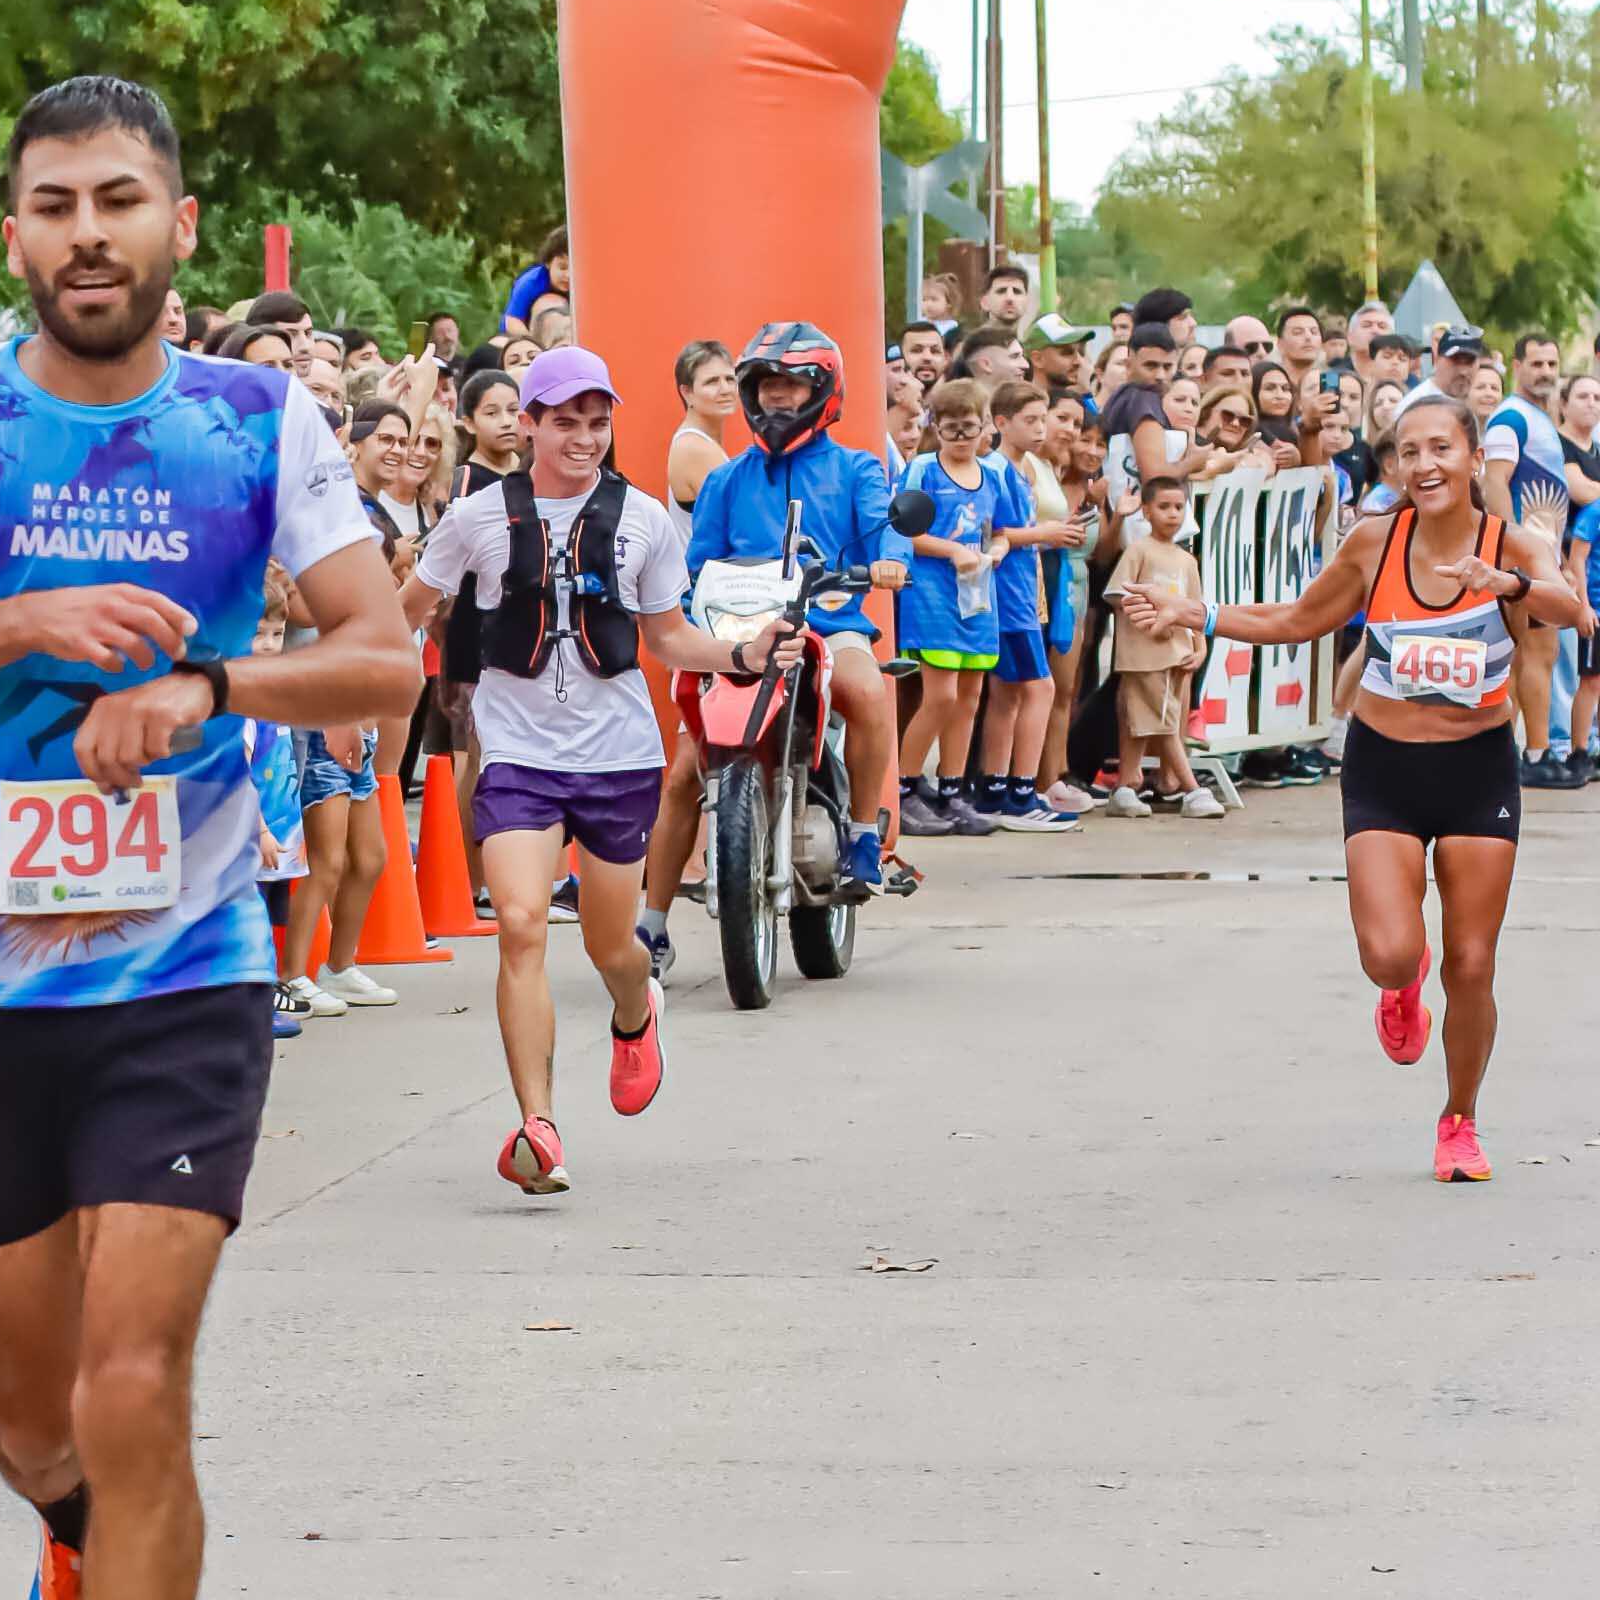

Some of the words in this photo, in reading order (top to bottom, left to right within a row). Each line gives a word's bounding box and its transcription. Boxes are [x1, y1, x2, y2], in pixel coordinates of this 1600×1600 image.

[32, 482, 172, 506] MARATÓN
[140, 510, 170, 525] DE
[9, 524, 190, 562] MALVINAS
[1396, 642, 1478, 688] 465
[8, 791, 169, 878] 294
